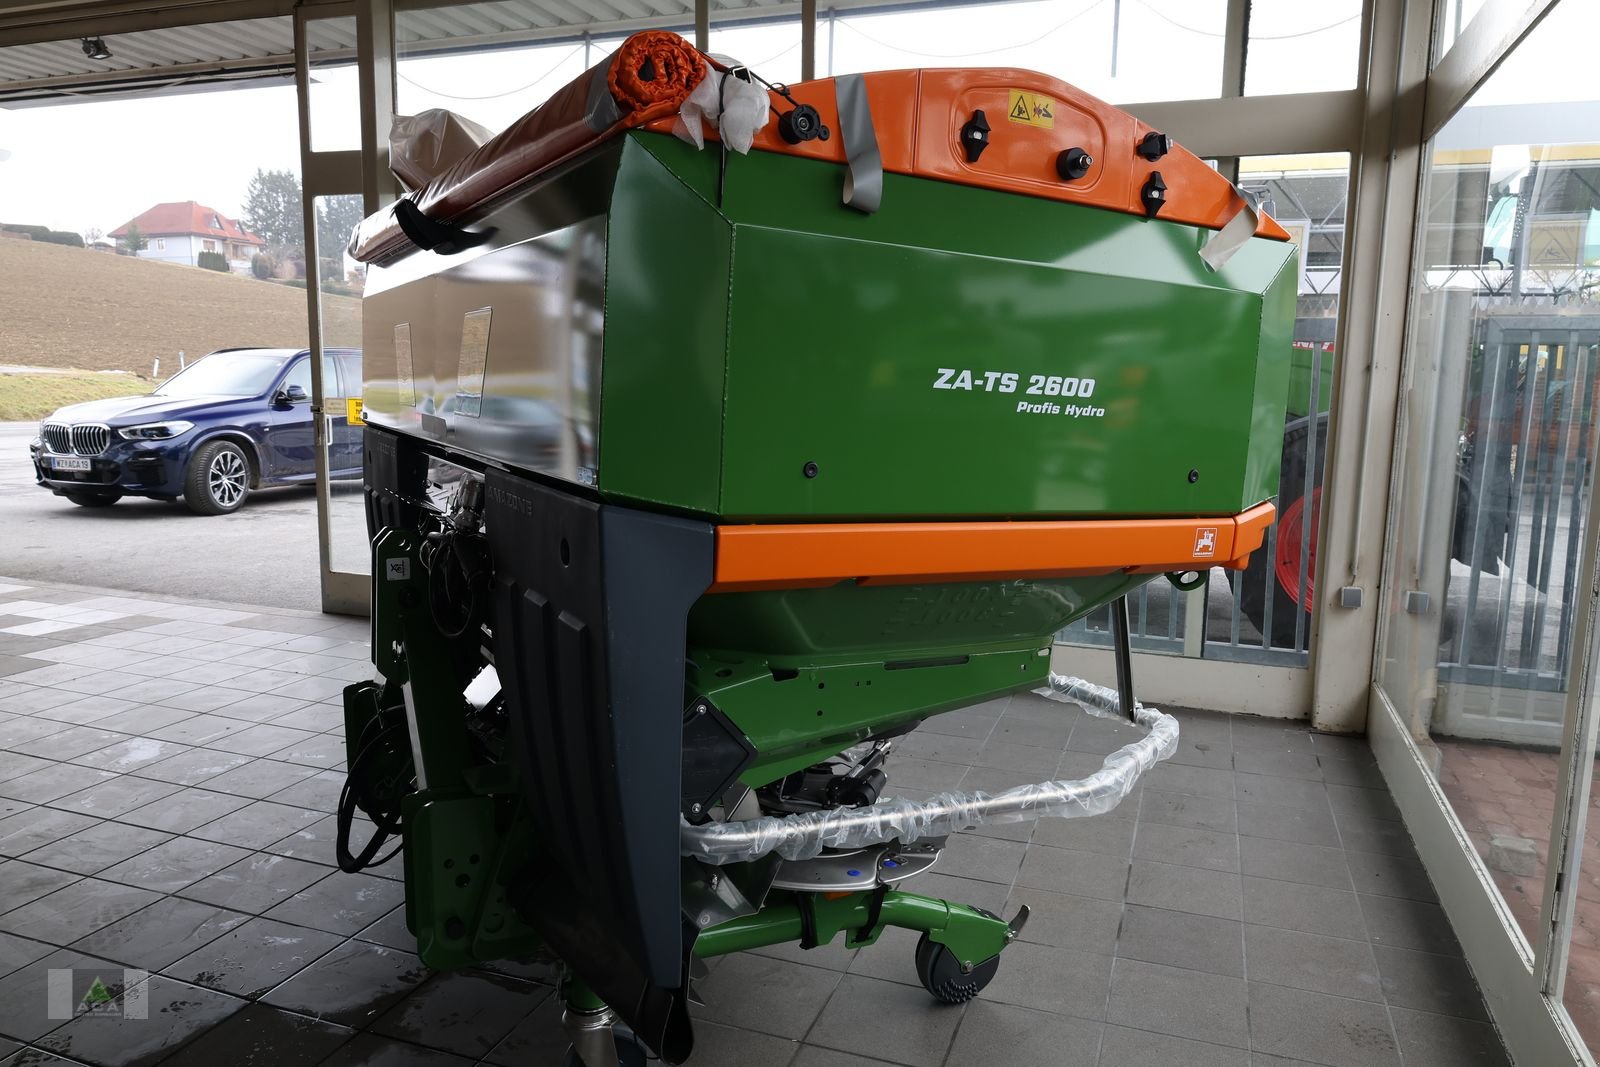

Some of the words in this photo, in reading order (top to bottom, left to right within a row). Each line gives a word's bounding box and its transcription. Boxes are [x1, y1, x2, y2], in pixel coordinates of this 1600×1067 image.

[933, 367, 1019, 393] ZA-TS
[1026, 374, 1096, 398] 2600
[1017, 401, 1060, 415] Profis
[1064, 404, 1106, 418] Hydro
